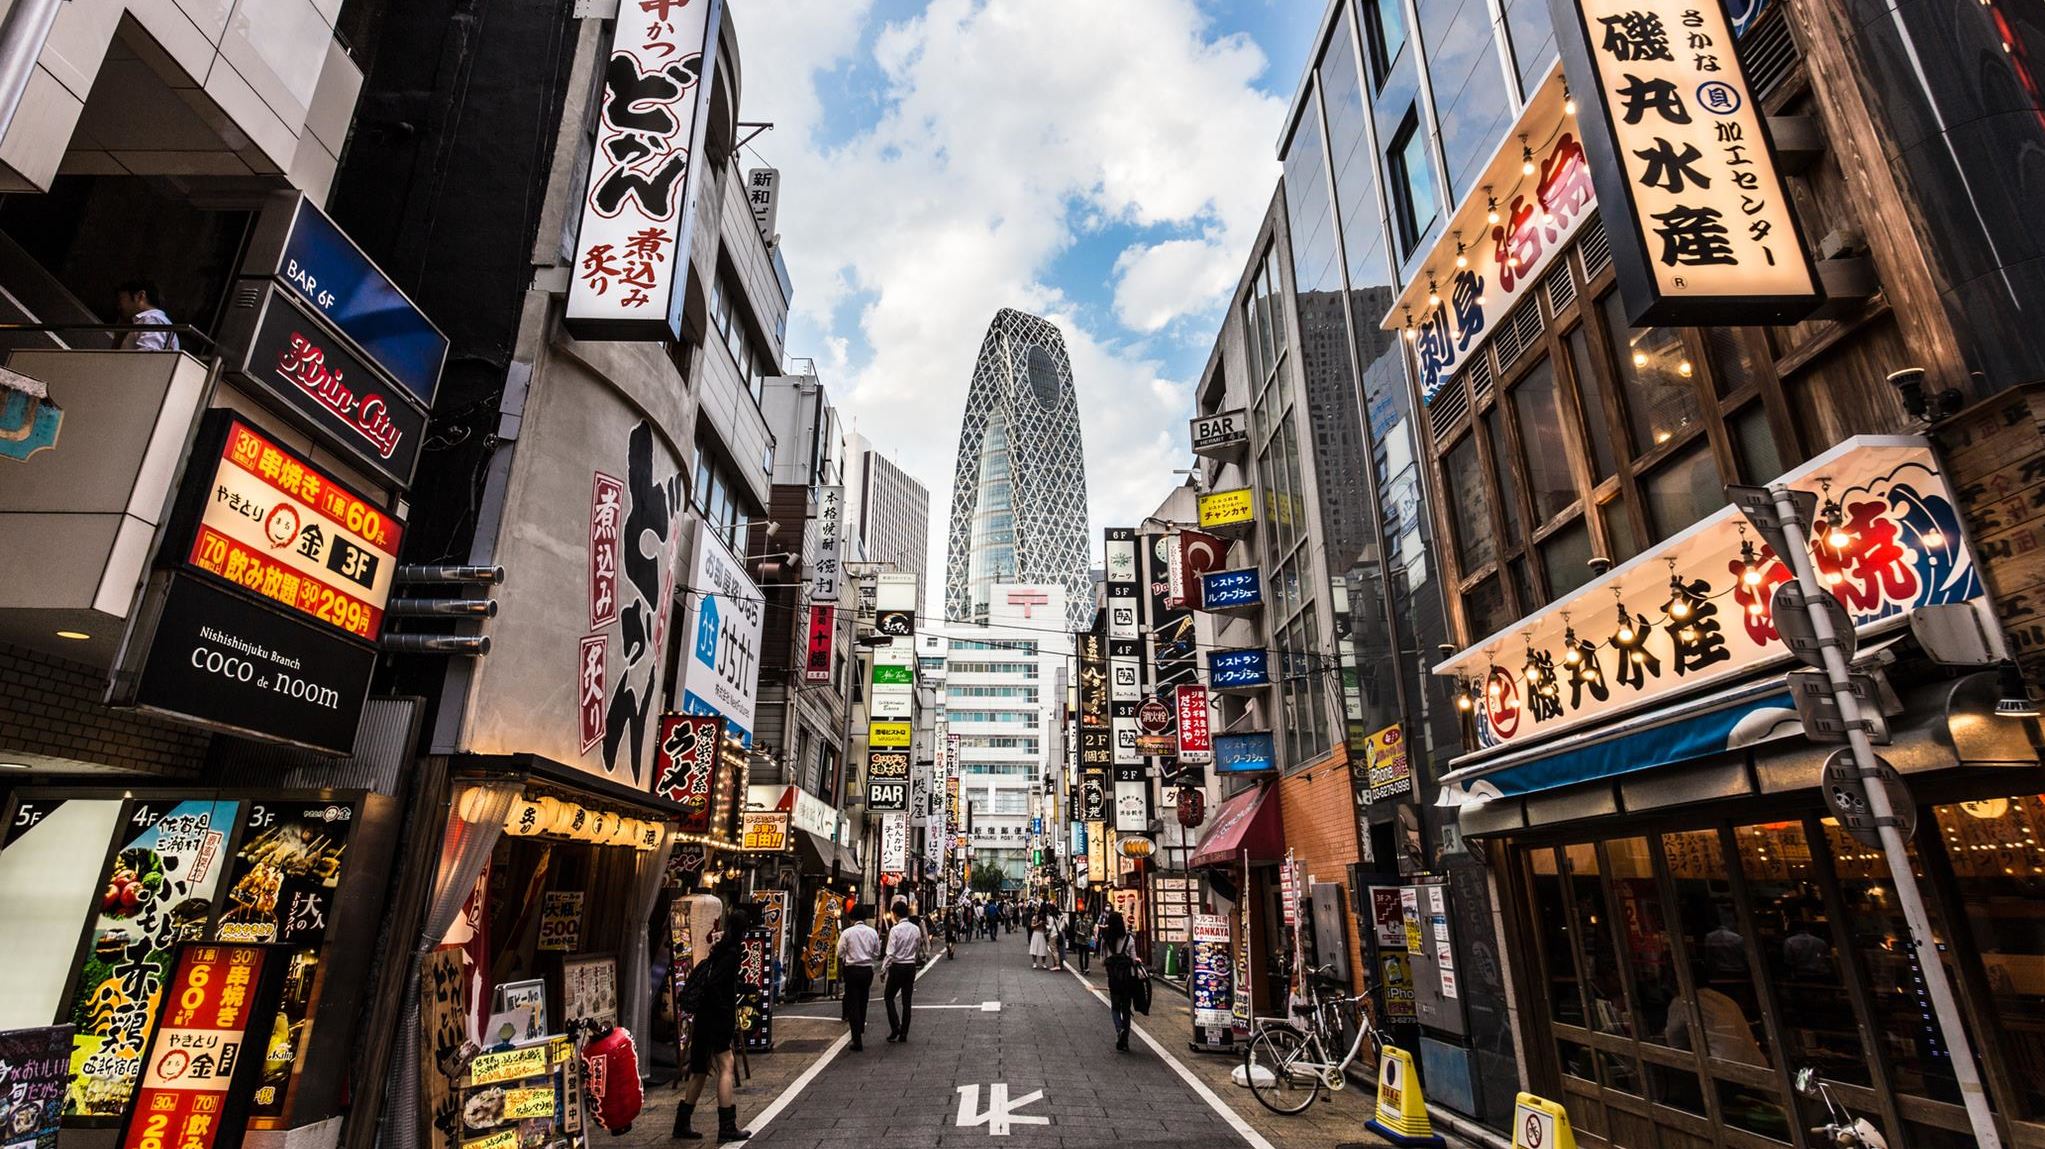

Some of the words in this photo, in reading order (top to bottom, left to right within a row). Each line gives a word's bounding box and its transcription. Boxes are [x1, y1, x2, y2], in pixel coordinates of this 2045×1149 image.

[1596, 10, 1739, 268] 磯丸水産
[1680, 10, 1722, 72] さかな
[1715, 120, 1776, 267] 加工センター
[582, 244, 622, 296] 炙り
[618, 227, 673, 308] 煮込み
[286, 259, 317, 297] BAR
[317, 289, 335, 309] 6F
[1415, 269, 1485, 384] 刺身
[279, 332, 402, 459] Kirin-City
[1199, 417, 1234, 438] BAR
[235, 433, 259, 458] 30
[257, 447, 321, 504] 串焼き
[346, 502, 381, 541] 60
[822, 490, 838, 551] 本格焼酎
[1205, 506, 1249, 520] チャンカヤ
[217, 485, 264, 522] やきとり
[296, 523, 324, 563] 金
[341, 546, 370, 581] 3F
[1112, 531, 1127, 540] 6F
[593, 488, 620, 613] 煮込み
[203, 535, 227, 564] 70
[224, 548, 300, 607] 飲み放題
[301, 582, 318, 602] 30
[315, 589, 361, 632] 299
[704, 549, 758, 628] お部屋探しなら
[1115, 587, 1130, 596] 5F
[1210, 575, 1252, 588] レストラン
[200, 625, 268, 660] Nishishinjuku
[270, 650, 301, 671] Branch
[1117, 646, 1132, 654] 4F
[1525, 578, 1731, 724] 磯丸水産
[1216, 655, 1260, 667] レストラン
[256, 675, 269, 689] de
[273, 672, 339, 709] noom
[582, 644, 603, 734] 炙り
[1119, 706, 1135, 716] 3F
[1142, 711, 1167, 723] 消火栓
[1180, 696, 1193, 743] だるまや
[1191, 691, 1201, 746] ジンギスカン
[1085, 734, 1108, 746] 2F
[1224, 741, 1265, 750] レストラン
[691, 723, 716, 793] 横浜家系
[1083, 750, 1110, 763] 個室
[1122, 770, 1138, 780] 2F
[1368, 764, 1394, 784] iPhone
[871, 786, 904, 802] BAR
[1086, 779, 1100, 818] 味香苑
[15, 804, 43, 827] 5F
[132, 804, 159, 827] 4F
[159, 814, 209, 837] 佐賀県
[248, 805, 276, 827] 3F
[156, 836, 202, 854] 三瀬村
[744, 832, 783, 849] 自由!!
[883, 825, 893, 864] チャーハン
[541, 919, 577, 937] 500
[1194, 914, 1229, 924] トルコ料理
[1194, 925, 1230, 937] CANKAYA
[232, 950, 250, 964] 30
[181, 964, 210, 1010] 60
[215, 965, 252, 1027] 串焼き
[169, 1034, 219, 1049] やきとり
[187, 1052, 215, 1079] 金
[220, 1045, 234, 1073] 3F
[195, 1096, 212, 1108] 70
[567, 1077, 578, 1121] 営業中
